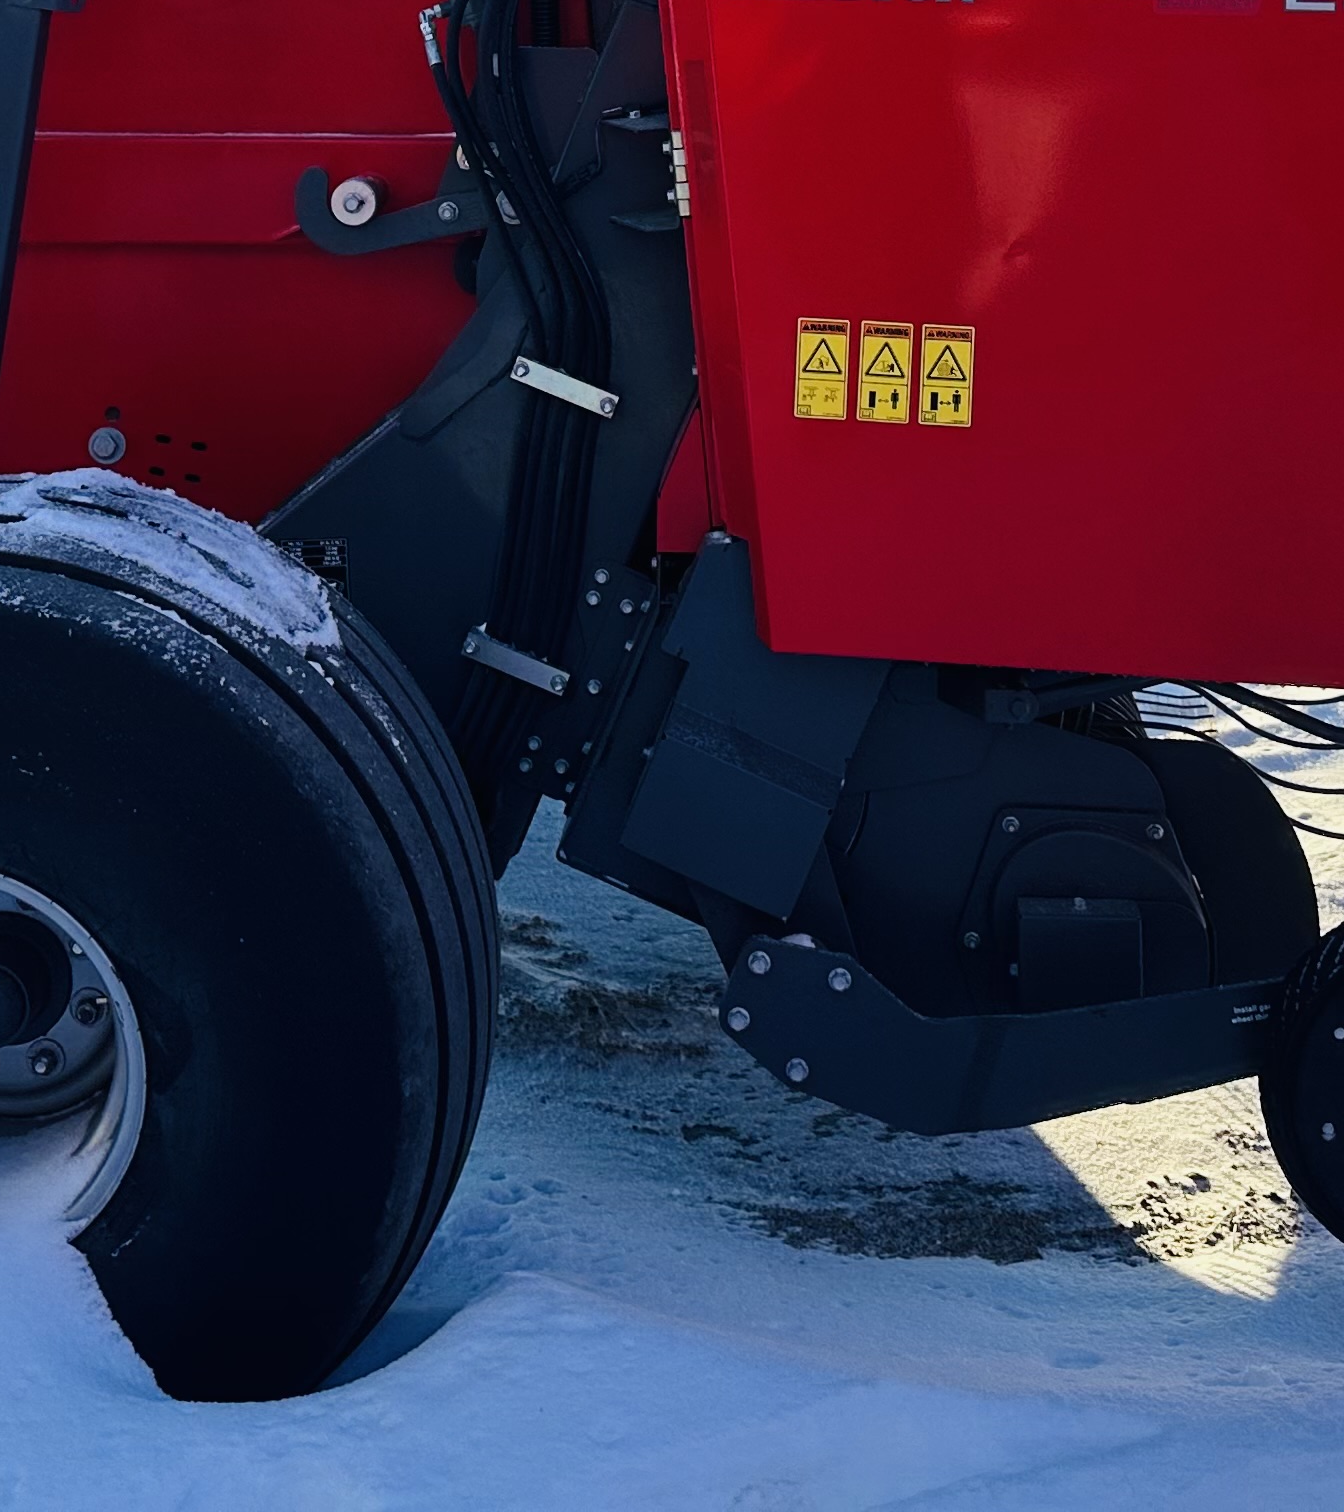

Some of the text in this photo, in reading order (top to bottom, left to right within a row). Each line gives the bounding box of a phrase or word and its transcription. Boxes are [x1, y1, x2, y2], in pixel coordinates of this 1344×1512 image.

[809, 323, 846, 333] WARNING
[873, 326, 909, 336] WARNING
[935, 330, 970, 339] WARNING
